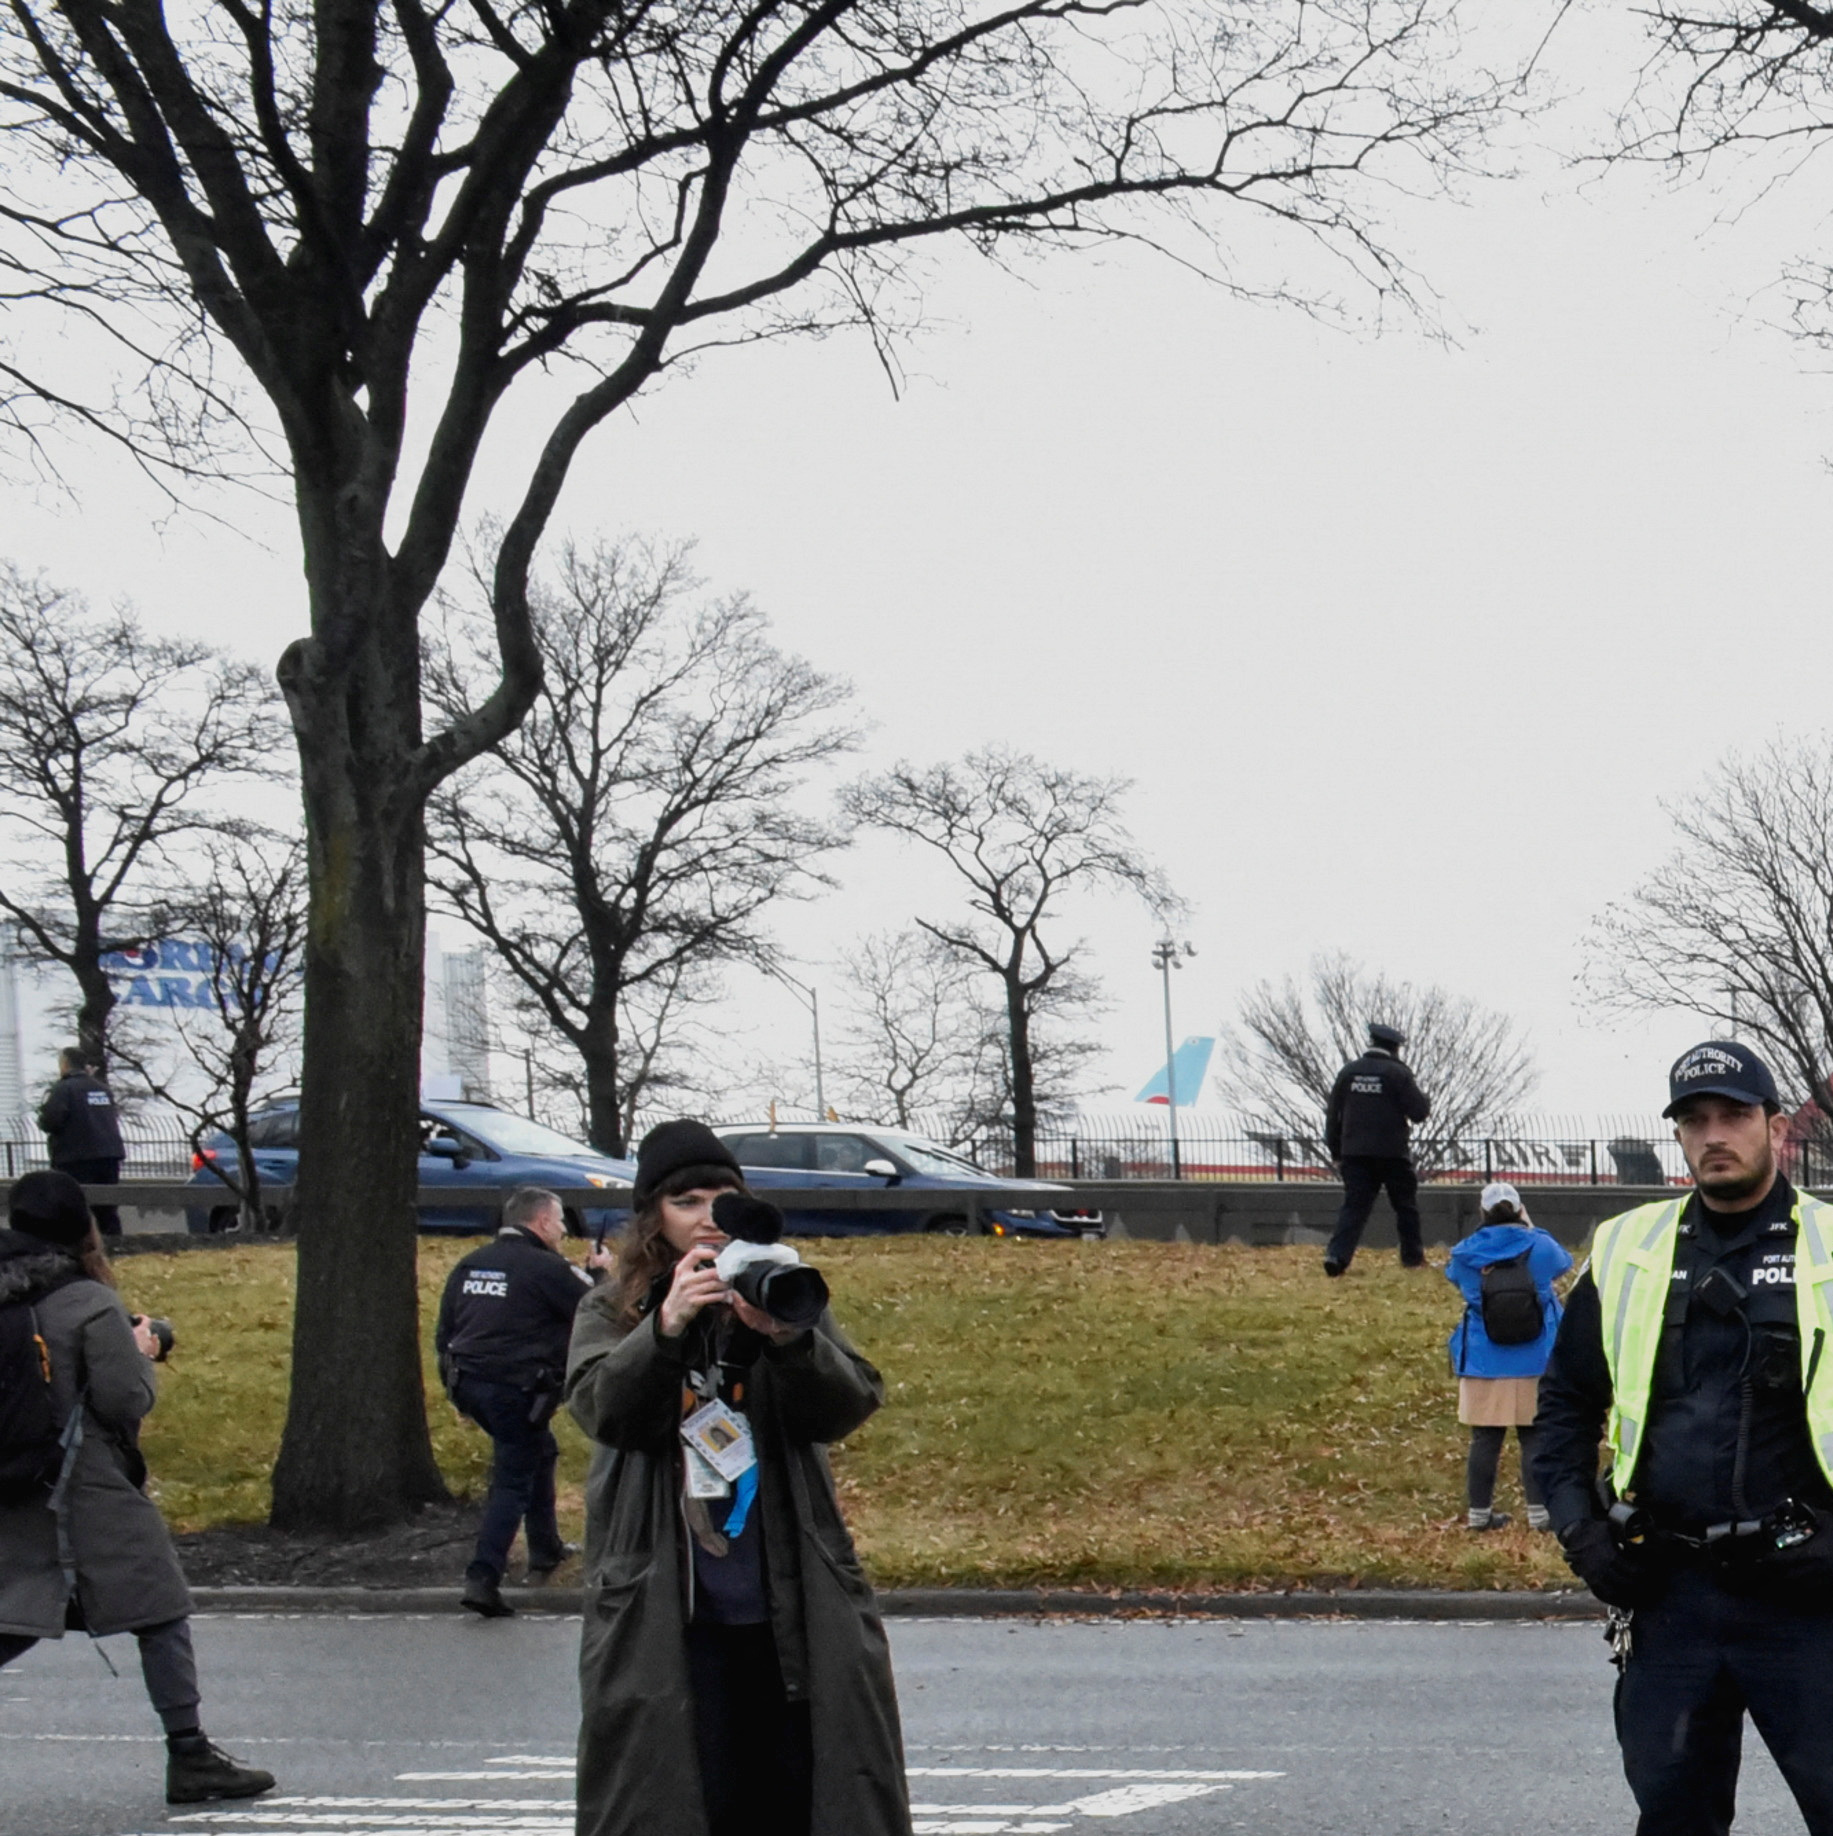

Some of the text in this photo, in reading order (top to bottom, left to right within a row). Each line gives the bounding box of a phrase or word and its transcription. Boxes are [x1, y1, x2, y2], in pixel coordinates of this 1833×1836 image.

[1683, 1062, 1726, 1081] POLICE
[1351, 1082, 1382, 1093] POLICE
[1769, 1222, 1788, 1232] JFK
[1752, 1267, 1796, 1285] POLI
[463, 1280, 508, 1297] POLICE
